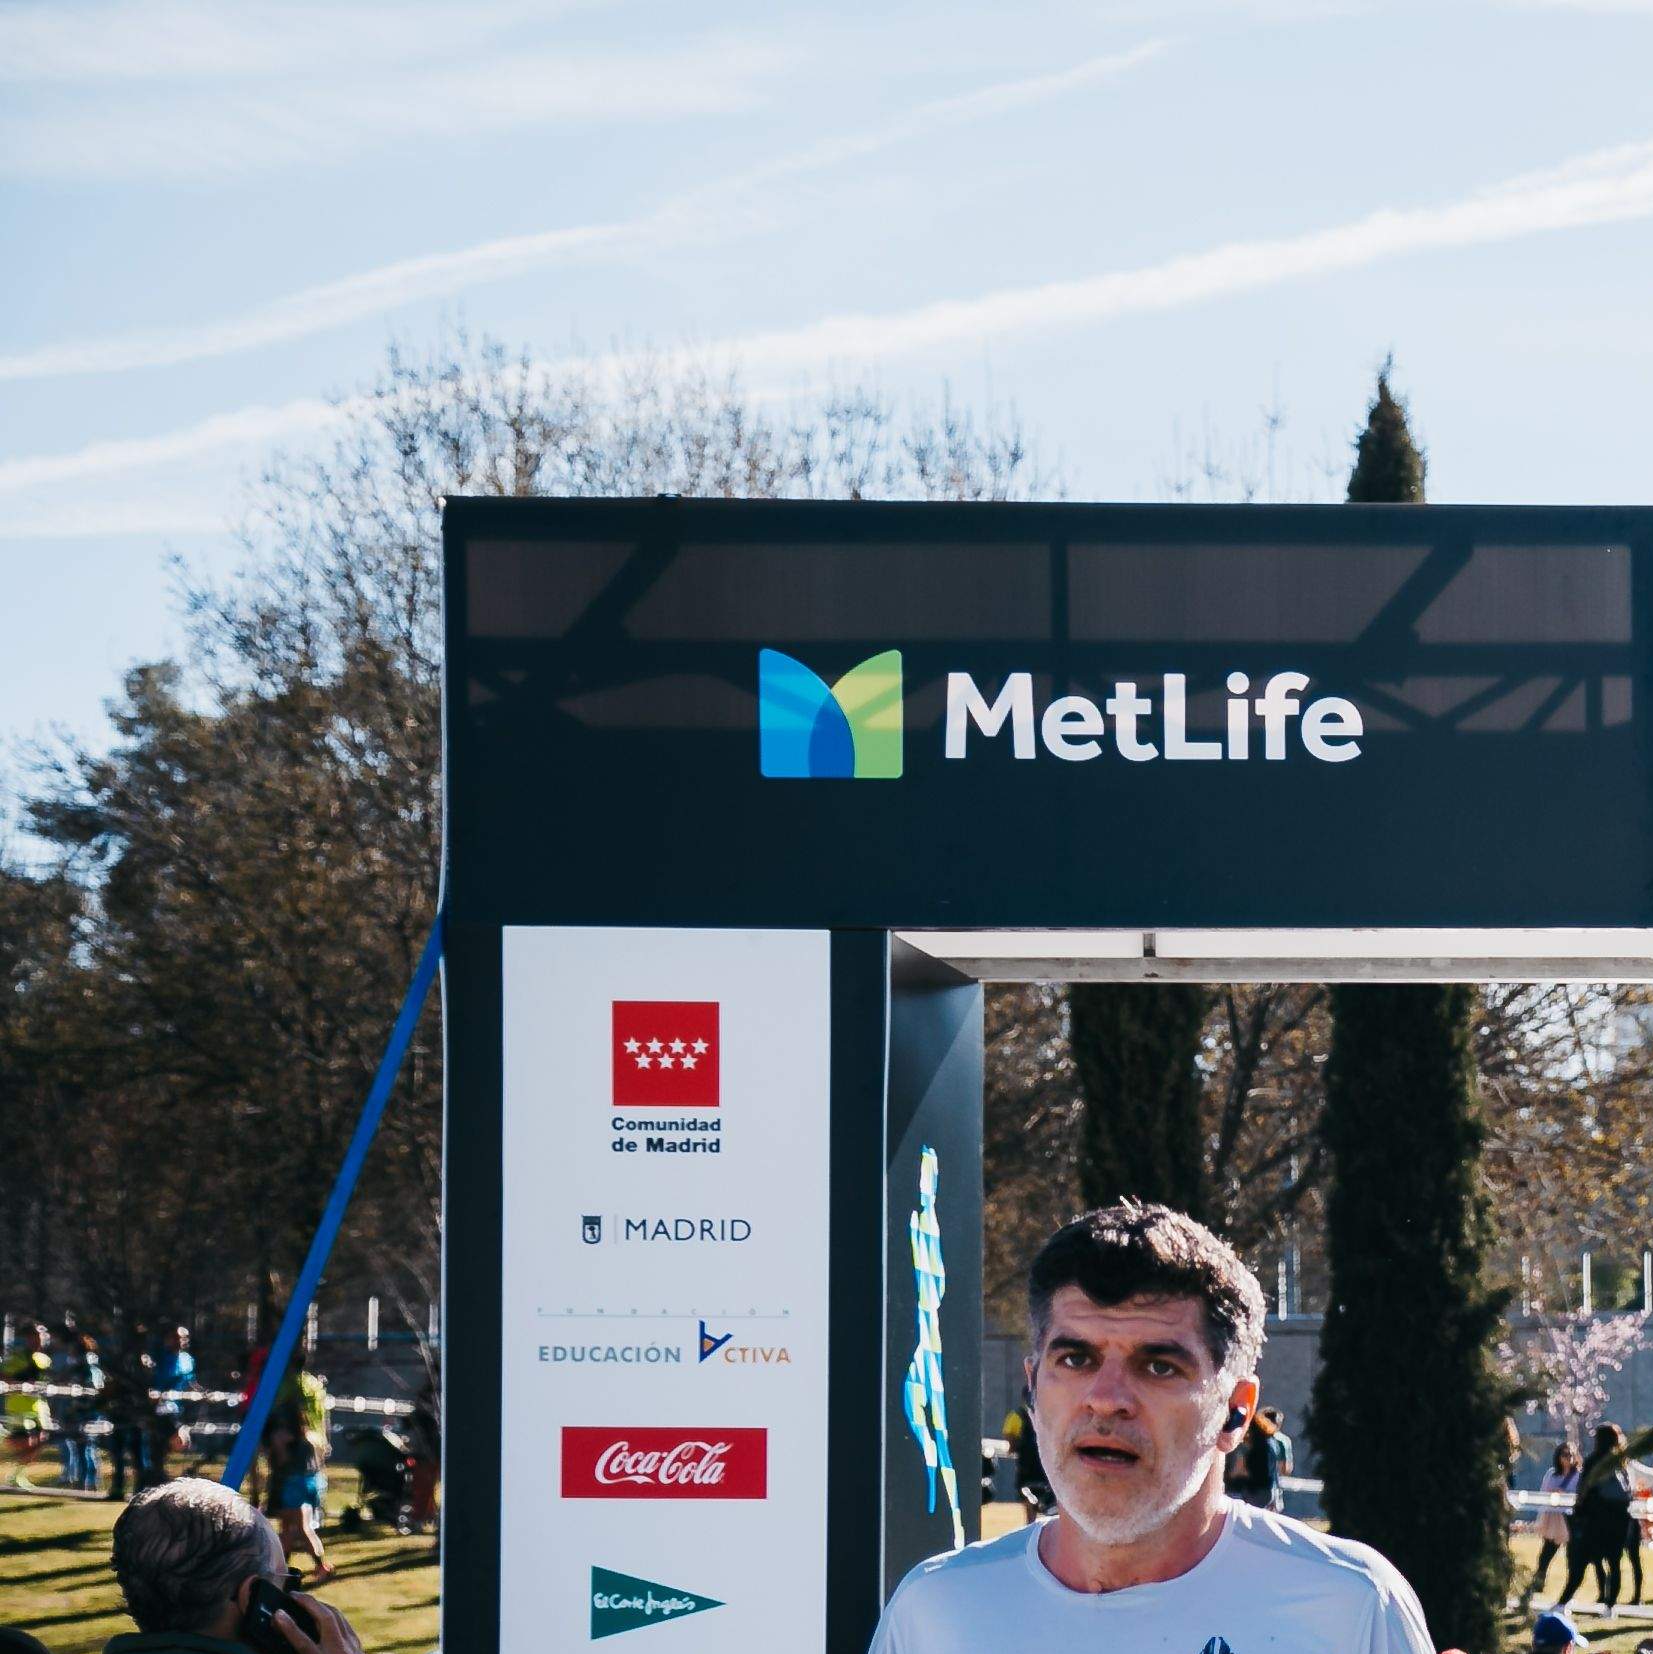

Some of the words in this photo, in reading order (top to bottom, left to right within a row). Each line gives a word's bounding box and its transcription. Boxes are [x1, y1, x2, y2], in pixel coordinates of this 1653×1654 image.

[945, 670, 1364, 763] MetLife
[612, 1117, 722, 1132] Comunidad
[612, 1137, 638, 1154] de
[645, 1137, 722, 1154] Madrid
[624, 1218, 752, 1242] MADRID
[538, 1340, 682, 1363] EDUCACIÓN
